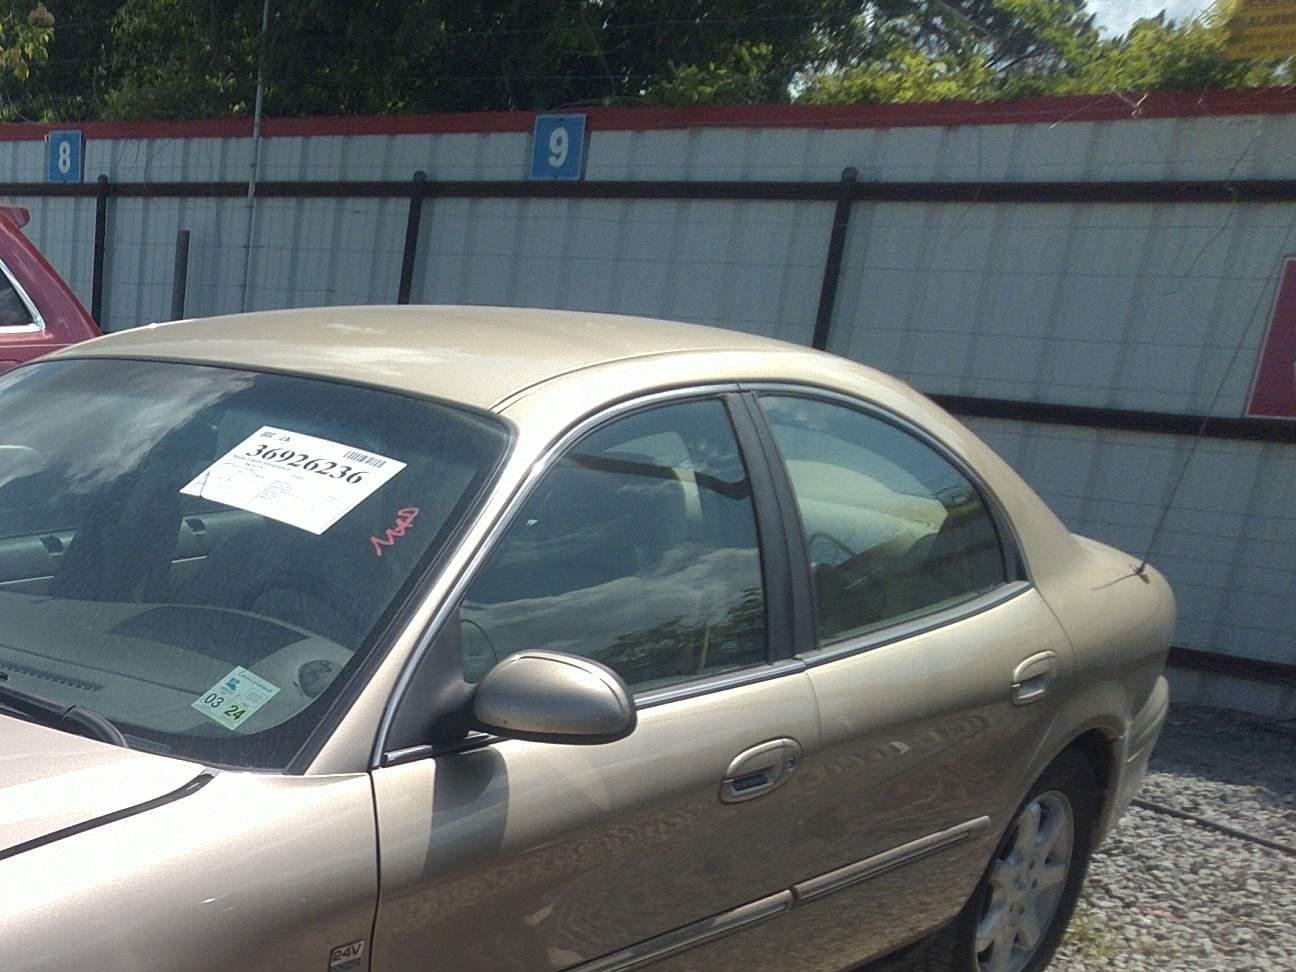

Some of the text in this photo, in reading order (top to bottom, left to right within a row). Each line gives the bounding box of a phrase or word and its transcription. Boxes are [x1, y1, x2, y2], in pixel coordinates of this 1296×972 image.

[58, 141, 71, 174] 8
[548, 127, 569, 167] 9
[245, 444, 368, 485] 36926236
[204, 693, 246, 720] 03 24
[333, 943, 362, 961] 24V
